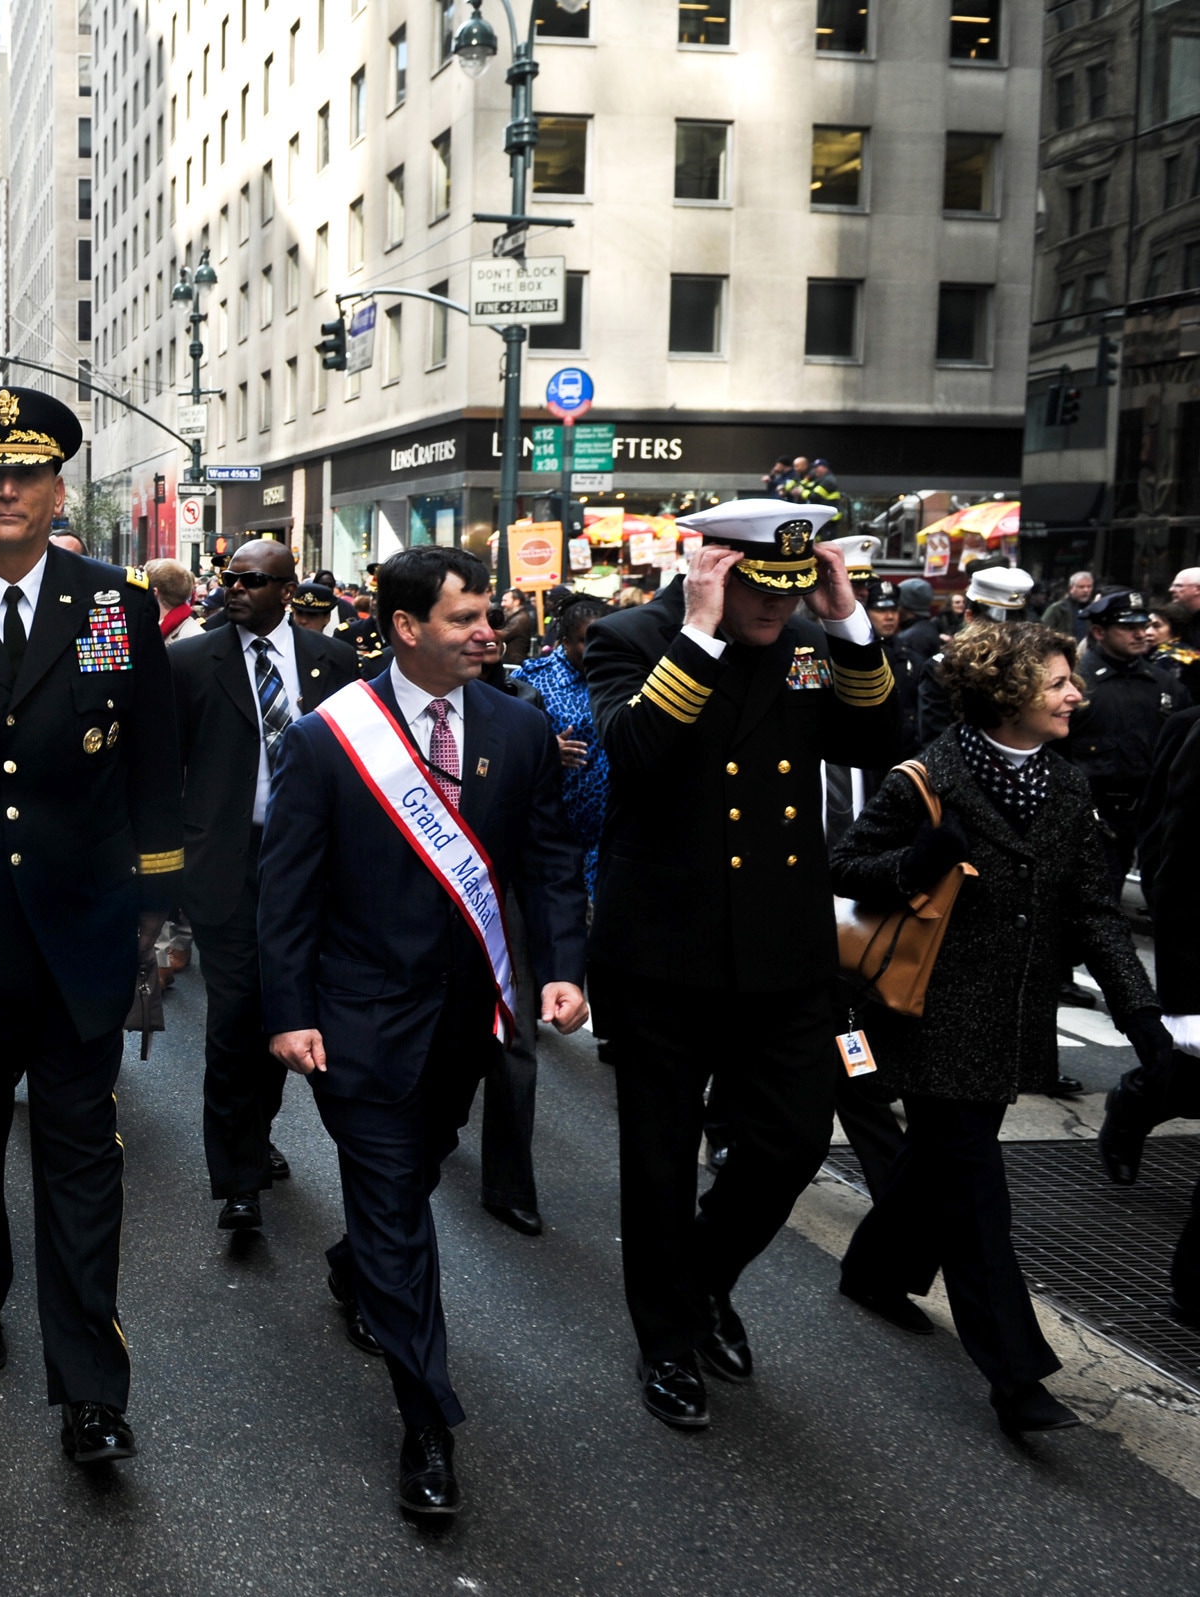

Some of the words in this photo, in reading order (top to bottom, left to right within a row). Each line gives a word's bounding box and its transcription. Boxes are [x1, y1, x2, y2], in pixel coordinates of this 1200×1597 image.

[477, 269, 511, 280] DON'T
[516, 267, 557, 278] BLOCK
[492, 282, 513, 292] THE
[519, 281, 543, 291] BOX
[209, 469, 229, 478] West
[230, 469, 248, 478] 45th
[249, 469, 259, 478] St
[402, 786, 458, 851] Grand
[451, 855, 496, 931] Marshal
